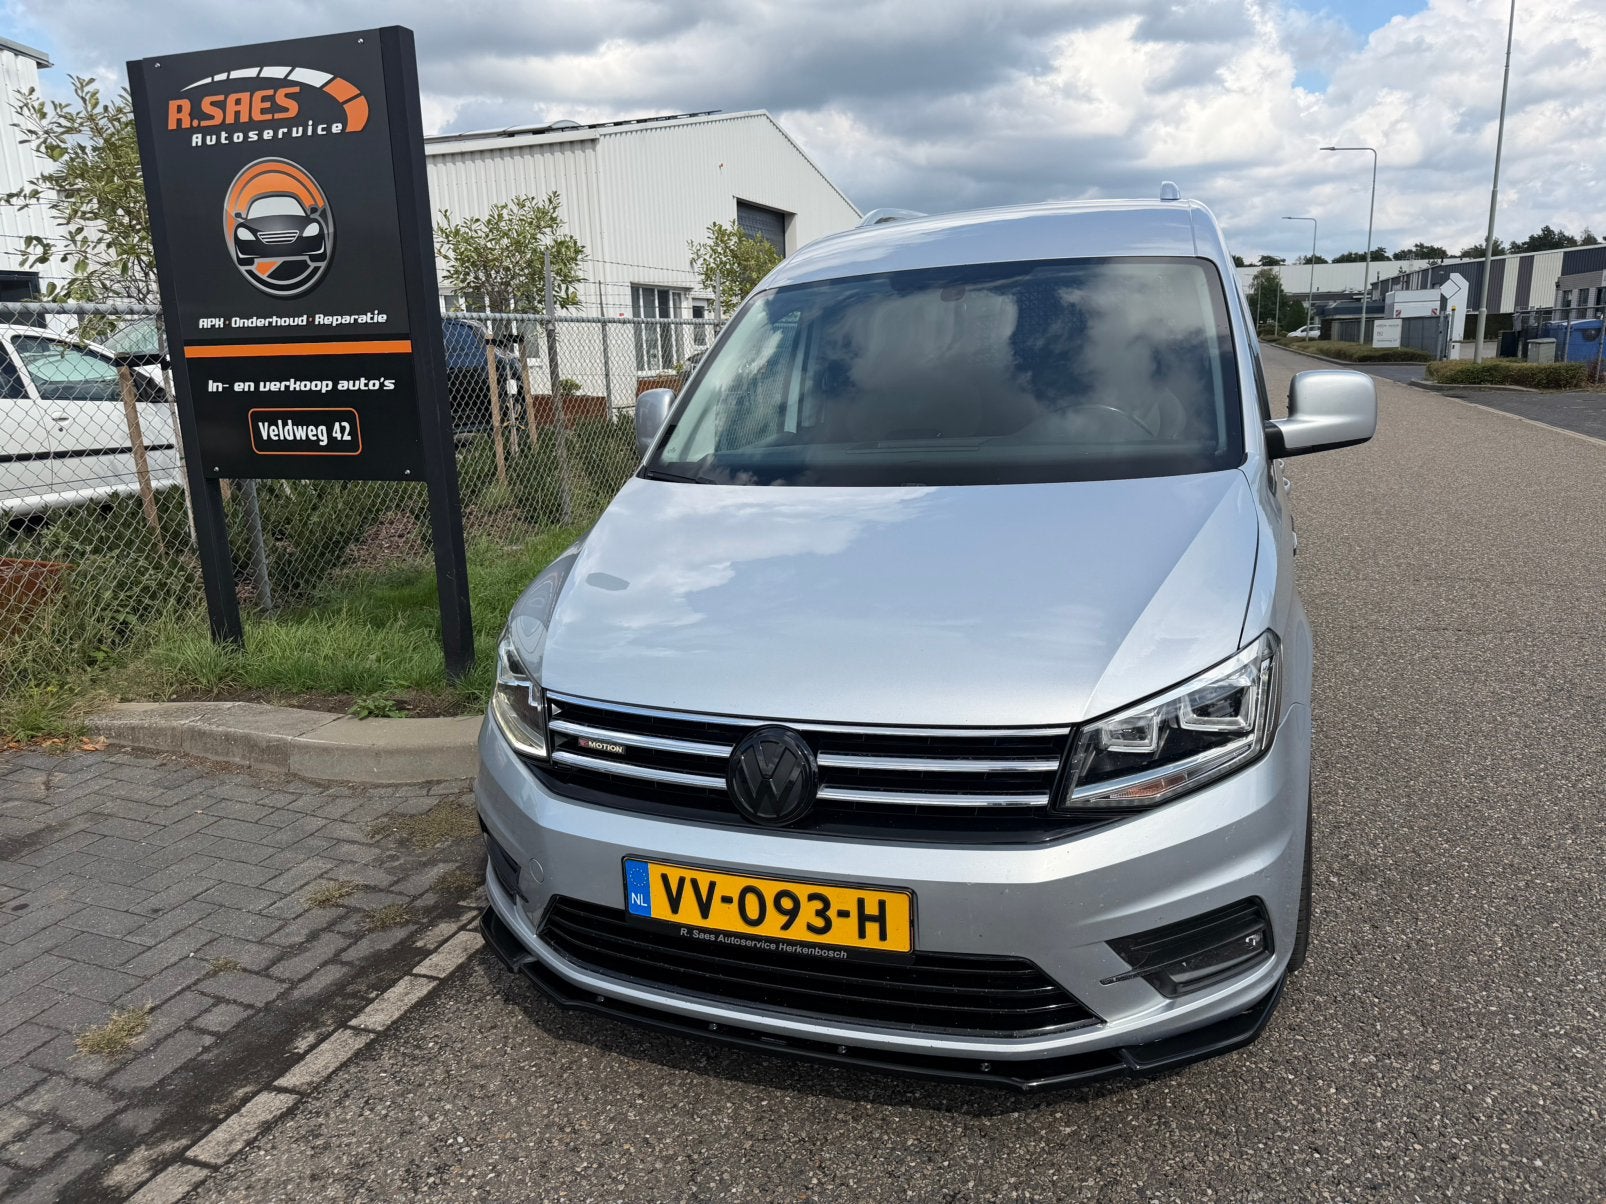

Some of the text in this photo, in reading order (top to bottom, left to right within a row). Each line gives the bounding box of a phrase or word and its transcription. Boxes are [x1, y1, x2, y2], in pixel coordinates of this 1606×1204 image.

[167, 86, 300, 130] R.SAES
[191, 120, 343, 147] Autoservice
[231, 314, 307, 328] Onderhoud
[314, 309, 387, 326] Reparatie
[208, 377, 395, 393] In- en verkoop auto's
[258, 419, 351, 446] Veldweg 42
[631, 892, 648, 907] NL
[660, 872, 888, 942] VV-093-H
[680, 927, 848, 959] R. Saes Autoservice Herkenbosch
